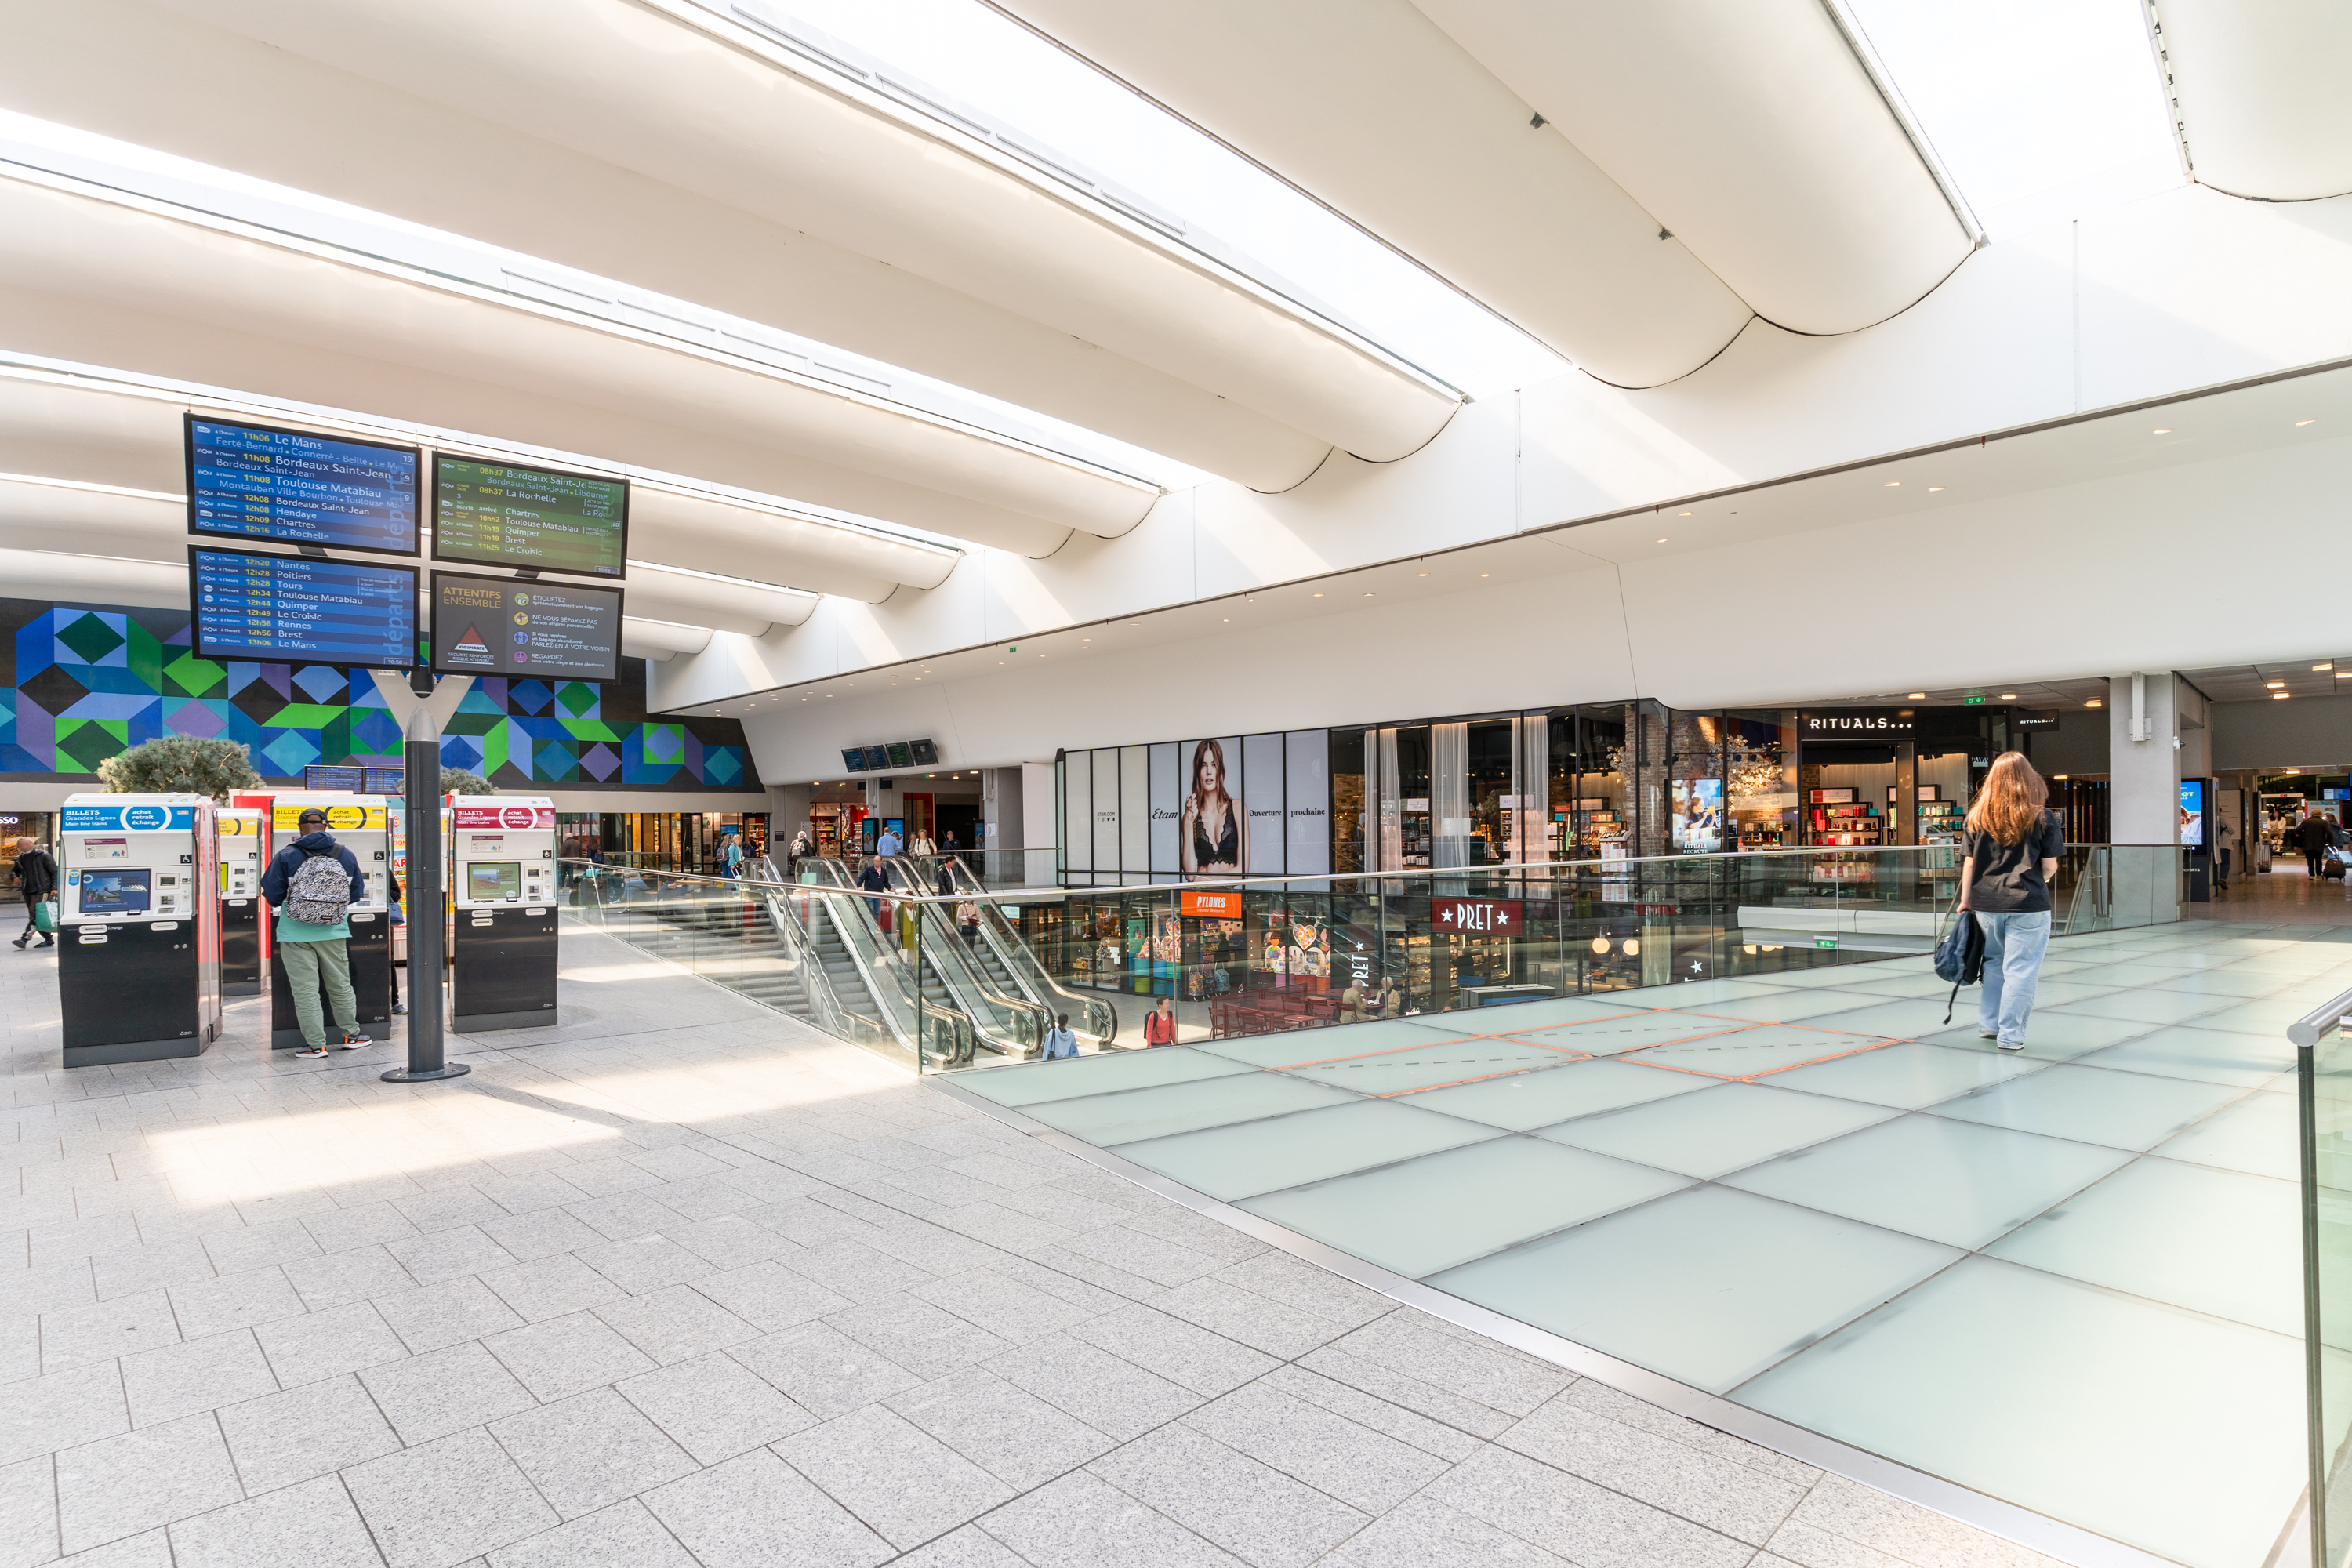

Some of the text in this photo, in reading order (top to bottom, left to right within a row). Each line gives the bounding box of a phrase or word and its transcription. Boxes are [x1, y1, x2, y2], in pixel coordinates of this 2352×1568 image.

[243, 432, 270, 442] 11h06
[275, 434, 289, 445] Le
[292, 437, 322, 450] Mans
[216, 437, 368, 466] Ferté-Bernard Connerré Beillé
[216, 458, 315, 478] Bordeaux Saint-Jean
[243, 453, 270, 463] 11h08
[275, 456, 329, 471] Bordeaux
[332, 463, 391, 480] Saint-Jean
[479, 467, 503, 476] 08h37
[507, 470, 548, 483] Bordeaux
[244, 474, 270, 484] 11h08
[275, 476, 328, 492] Toulouse
[330, 483, 382, 498] Matabiau
[487, 477, 608, 499] Bordeaux Saint-Jean Libourne
[220, 480, 384, 507] Montauban Ville Bourbon Toulouse
[479, 486, 503, 495] 08h37
[506, 489, 517, 498] La
[519, 491, 557, 503] Rochelle
[245, 505, 317, 520] 12h08 Hendaye
[276, 497, 320, 509] Bordeaux
[321, 503, 369, 515] Saint-Jean
[506, 508, 539, 519] Chartres
[245, 515, 316, 529] 12h09 Chartres
[506, 517, 541, 528] Toulouse
[543, 522, 579, 532] Matabiau
[245, 525, 270, 534] 12h16
[290, 529, 329, 540] Rochelle
[505, 527, 540, 537] Quimper
[505, 536, 525, 545] Brest
[516, 546, 543, 556] Croisic
[277, 561, 310, 571] Nantes
[277, 571, 312, 581] Poitiers
[277, 580, 303, 590] Tours
[277, 590, 318, 601] Toulouse
[321, 594, 363, 604] Matabiau
[442, 586, 502, 600] ATTENTIFS
[532, 594, 566, 604] ÉTIQUETEZ
[277, 601, 318, 611] Quimper
[443, 596, 502, 609] ENSEMBLE
[291, 612, 322, 621] Croisic
[383, 574, 409, 655] départs
[278, 620, 312, 630] Rennes
[292, 641, 317, 649] Mans
[1152, 808, 1178, 820] Etam
[1290, 808, 1325, 818] prochaine
[1197, 896, 1226, 908] PYLONES
[1457, 903, 1494, 931] PRET
